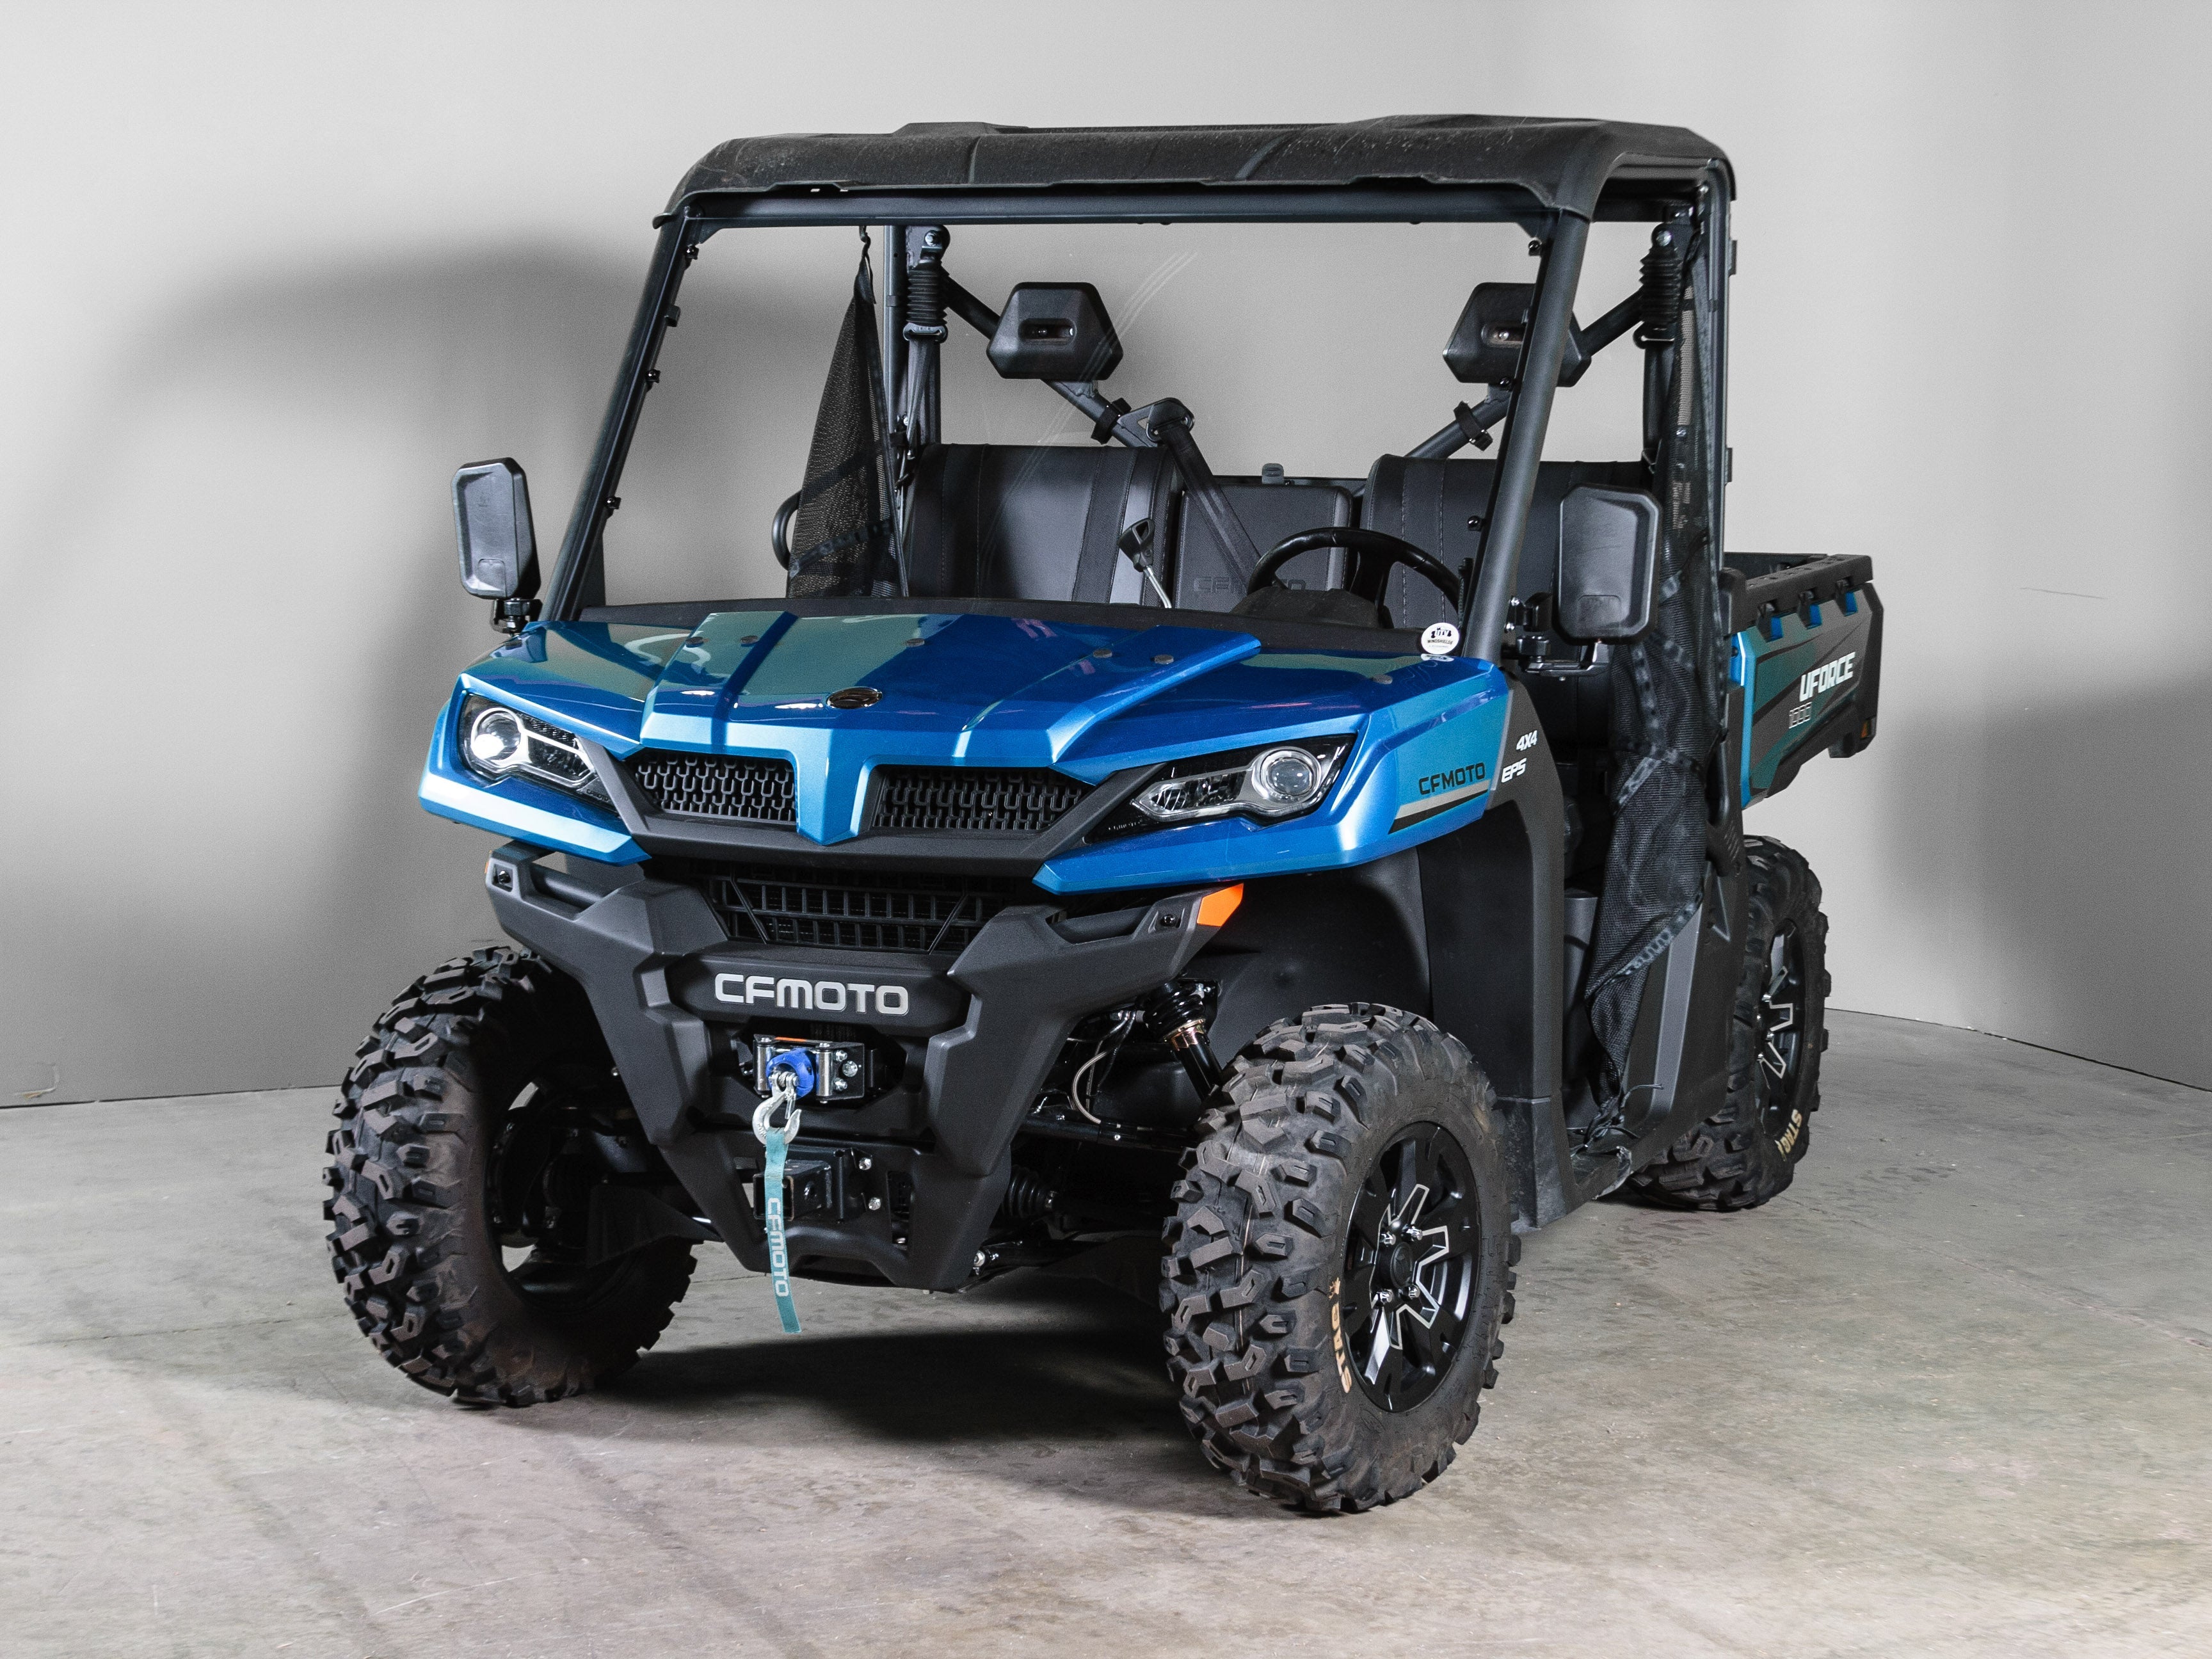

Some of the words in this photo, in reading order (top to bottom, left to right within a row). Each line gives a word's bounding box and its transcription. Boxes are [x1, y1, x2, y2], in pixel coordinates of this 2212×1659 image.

[1799, 652, 1855, 702] UFORCE
[1789, 701, 1813, 729] 1000
[1516, 730, 1537, 751] 4X4
[1418, 762, 1486, 795] CFMOTO
[1501, 757, 1527, 783] EPS
[715, 973, 909, 1015] CFMOTO
[1779, 1109, 1802, 1153] STAG
[768, 1198, 789, 1297] CFMOTO
[1331, 1302, 1352, 1393] STAG
